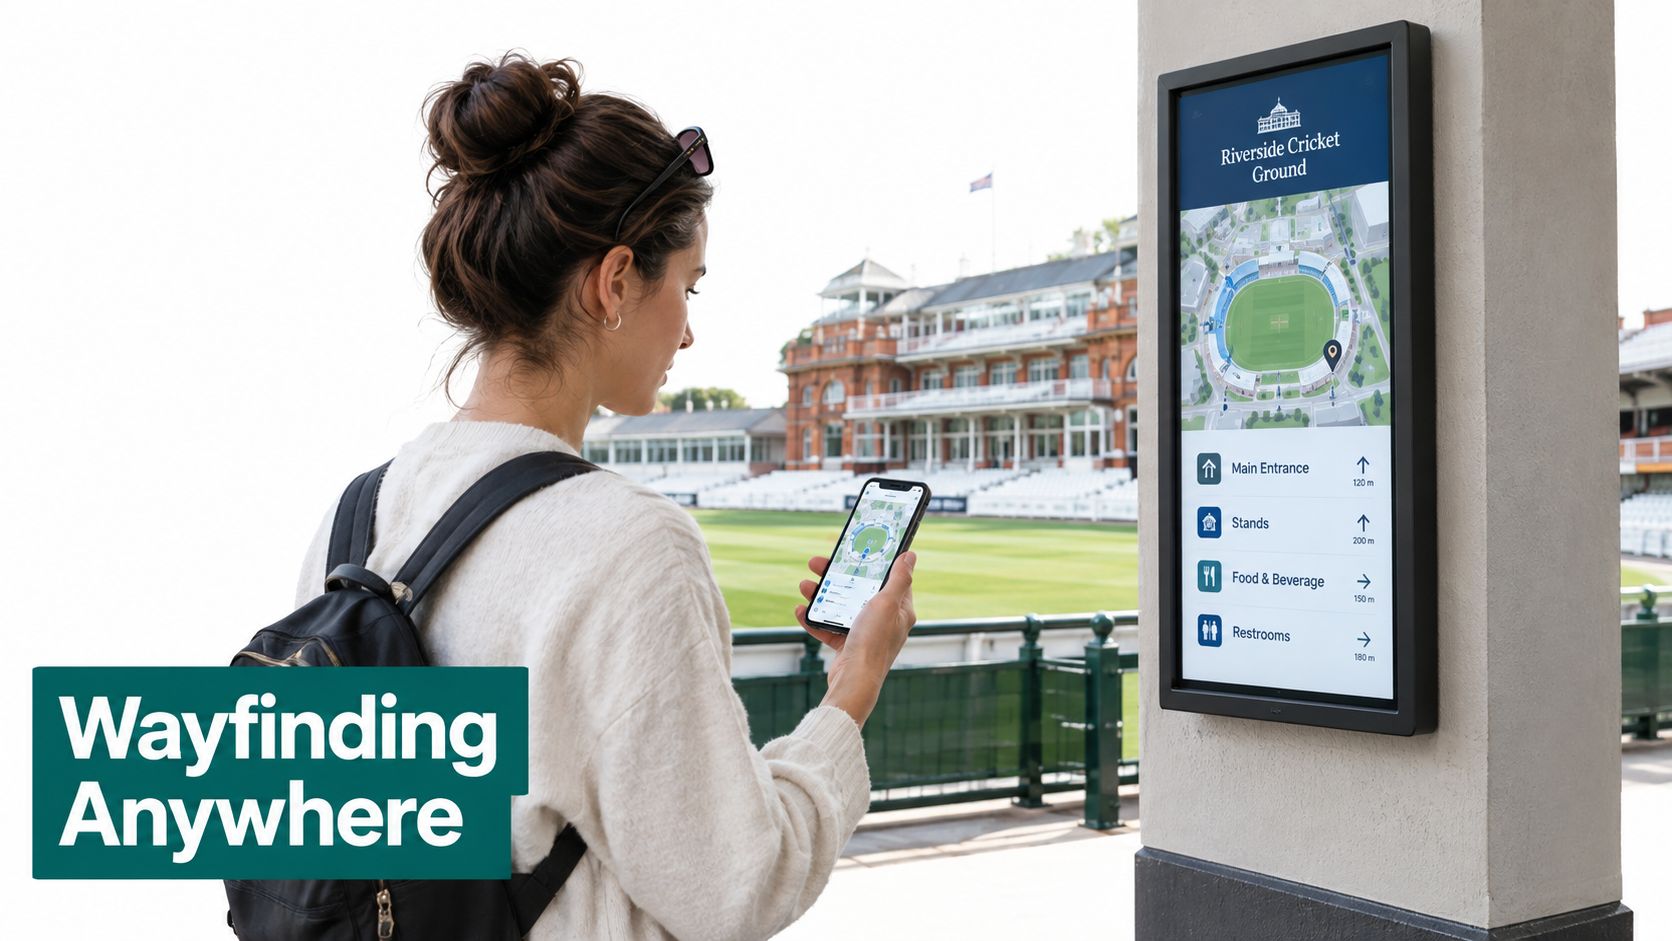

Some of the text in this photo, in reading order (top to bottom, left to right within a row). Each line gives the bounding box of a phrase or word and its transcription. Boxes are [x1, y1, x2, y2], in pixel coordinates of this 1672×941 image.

[1221, 130, 1340, 166] Riverside Cricket
[1252, 158, 1307, 183] Ground
[1232, 462, 1310, 475] Main Entrance
[1353, 479, 1366, 487] 120
[1232, 516, 1270, 529] Stands
[1353, 537, 1367, 545] 200
[1232, 571, 1325, 590] Food & Beverage
[1354, 595, 1367, 603] 150
[1233, 626, 1291, 642] Restrooms
[1354, 653, 1367, 662] 180
